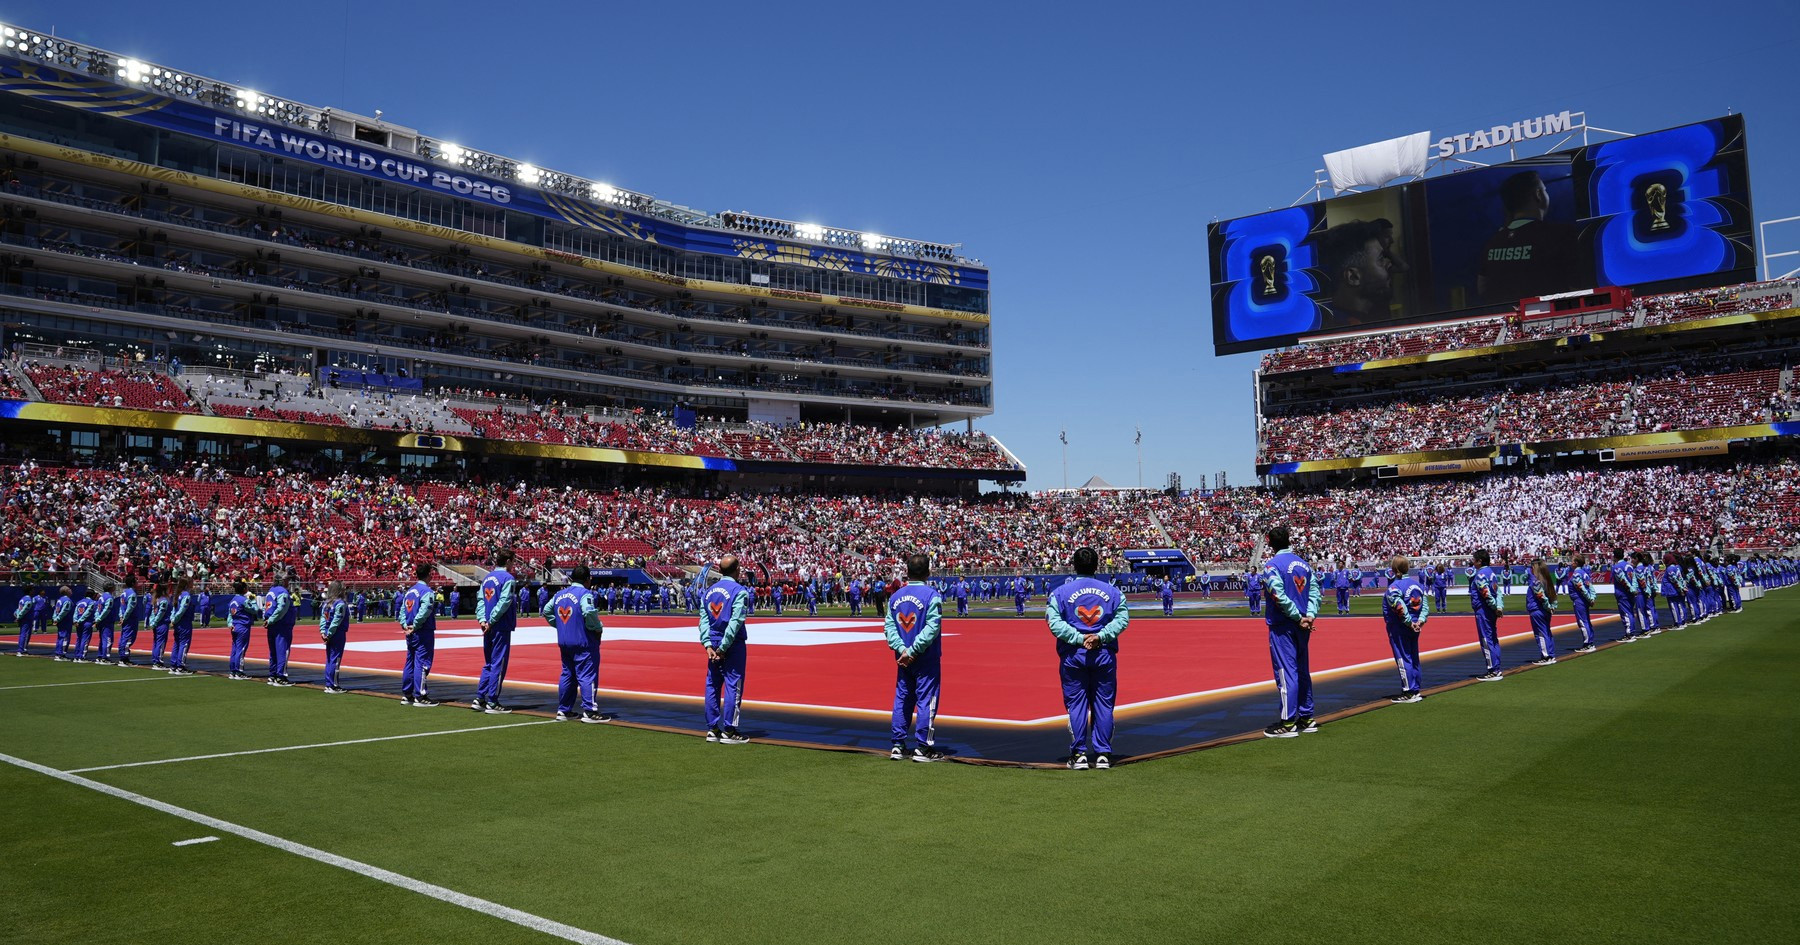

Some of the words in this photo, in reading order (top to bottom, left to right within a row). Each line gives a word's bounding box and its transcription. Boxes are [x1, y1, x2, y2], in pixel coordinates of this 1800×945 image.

[1438, 110, 1572, 159] STADIUM
[214, 116, 276, 149] FIFA
[281, 132, 377, 172] WORLD
[381, 158, 428, 183] CUP
[431, 171, 511, 203] 2026
[1487, 245, 1532, 261] SUISSE
[1637, 447, 1681, 456] FRANCISCO
[1424, 463, 1462, 472] #FIFAWorldCup
[1188, 582, 1219, 592] QAAR
[892, 595, 924, 610] VOLUNTEER
[1068, 587, 1111, 604] VOLUNTEER
